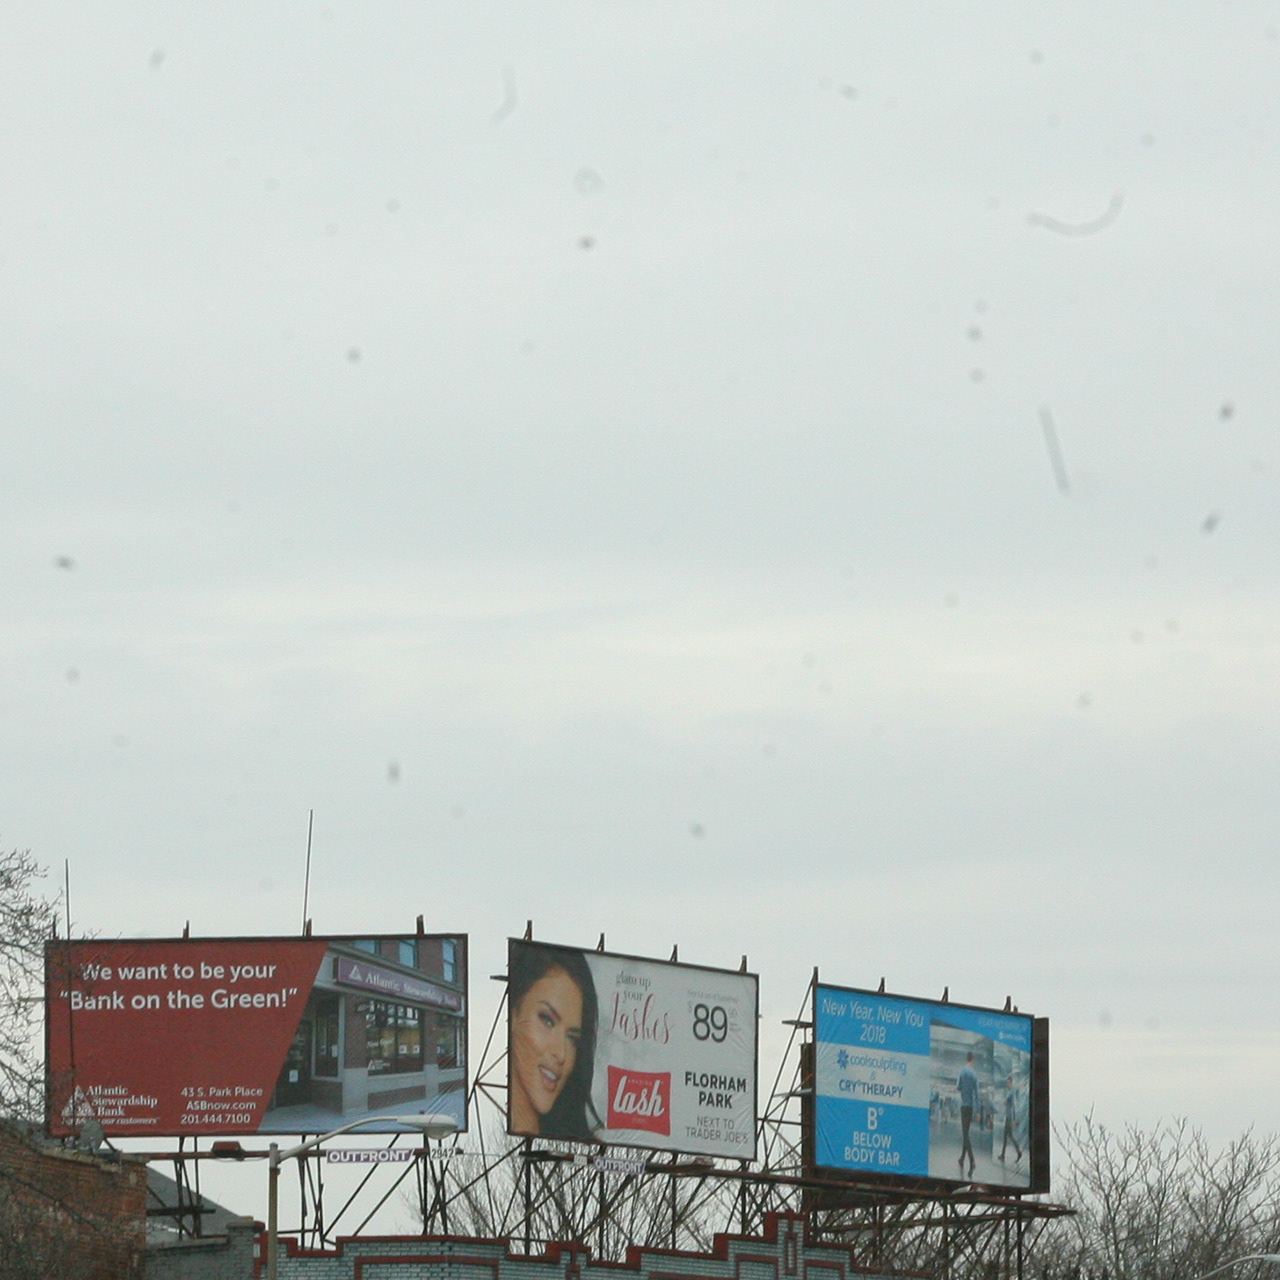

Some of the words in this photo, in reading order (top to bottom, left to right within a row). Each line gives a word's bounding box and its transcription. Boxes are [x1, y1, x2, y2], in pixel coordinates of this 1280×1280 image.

[81, 963, 112, 980] We
[118, 963, 168, 980] want
[173, 963, 195, 980] to
[200, 962, 225, 979] be
[230, 964, 277, 983] your
[131, 994, 160, 1010] on
[167, 990, 205, 1009] the
[822, 998, 847, 1016] New
[850, 1001, 874, 1021] Year,
[877, 1006, 902, 1024] New
[904, 1009, 925, 1027] You
[692, 1003, 728, 1043] 89
[860, 1023, 886, 1044] 2018
[850, 1054, 907, 1076] coolsculpting
[86, 1085, 128, 1095] Atlantic
[685, 1071, 747, 1093] FLORHAM
[181, 1087, 195, 1097] 43
[197, 1088, 206, 1097] S.
[209, 1087, 231, 1097] Park
[234, 1087, 264, 1096] Place
[699, 1091, 733, 1109] PARK
[91, 1095, 158, 1108] Stewardship
[186, 1101, 257, 1110] ASBnow.com
[97, 1106, 125, 1116] Bank
[180, 1114, 251, 1125] 201.444.7100
[696, 1116, 720, 1128] NEXT
[723, 1118, 735, 1130] TO
[685, 1127, 721, 1142] TRADER
[723, 1131, 749, 1144] JOE'S
[853, 1131, 892, 1149] BELOW
[329, 1150, 407, 1163] OUTFRONT
[431, 1149, 454, 1159] 2942
[844, 1146, 875, 1163] BODY
[878, 1151, 900, 1166] BAR
[595, 1158, 644, 1174] OUTFRONT
